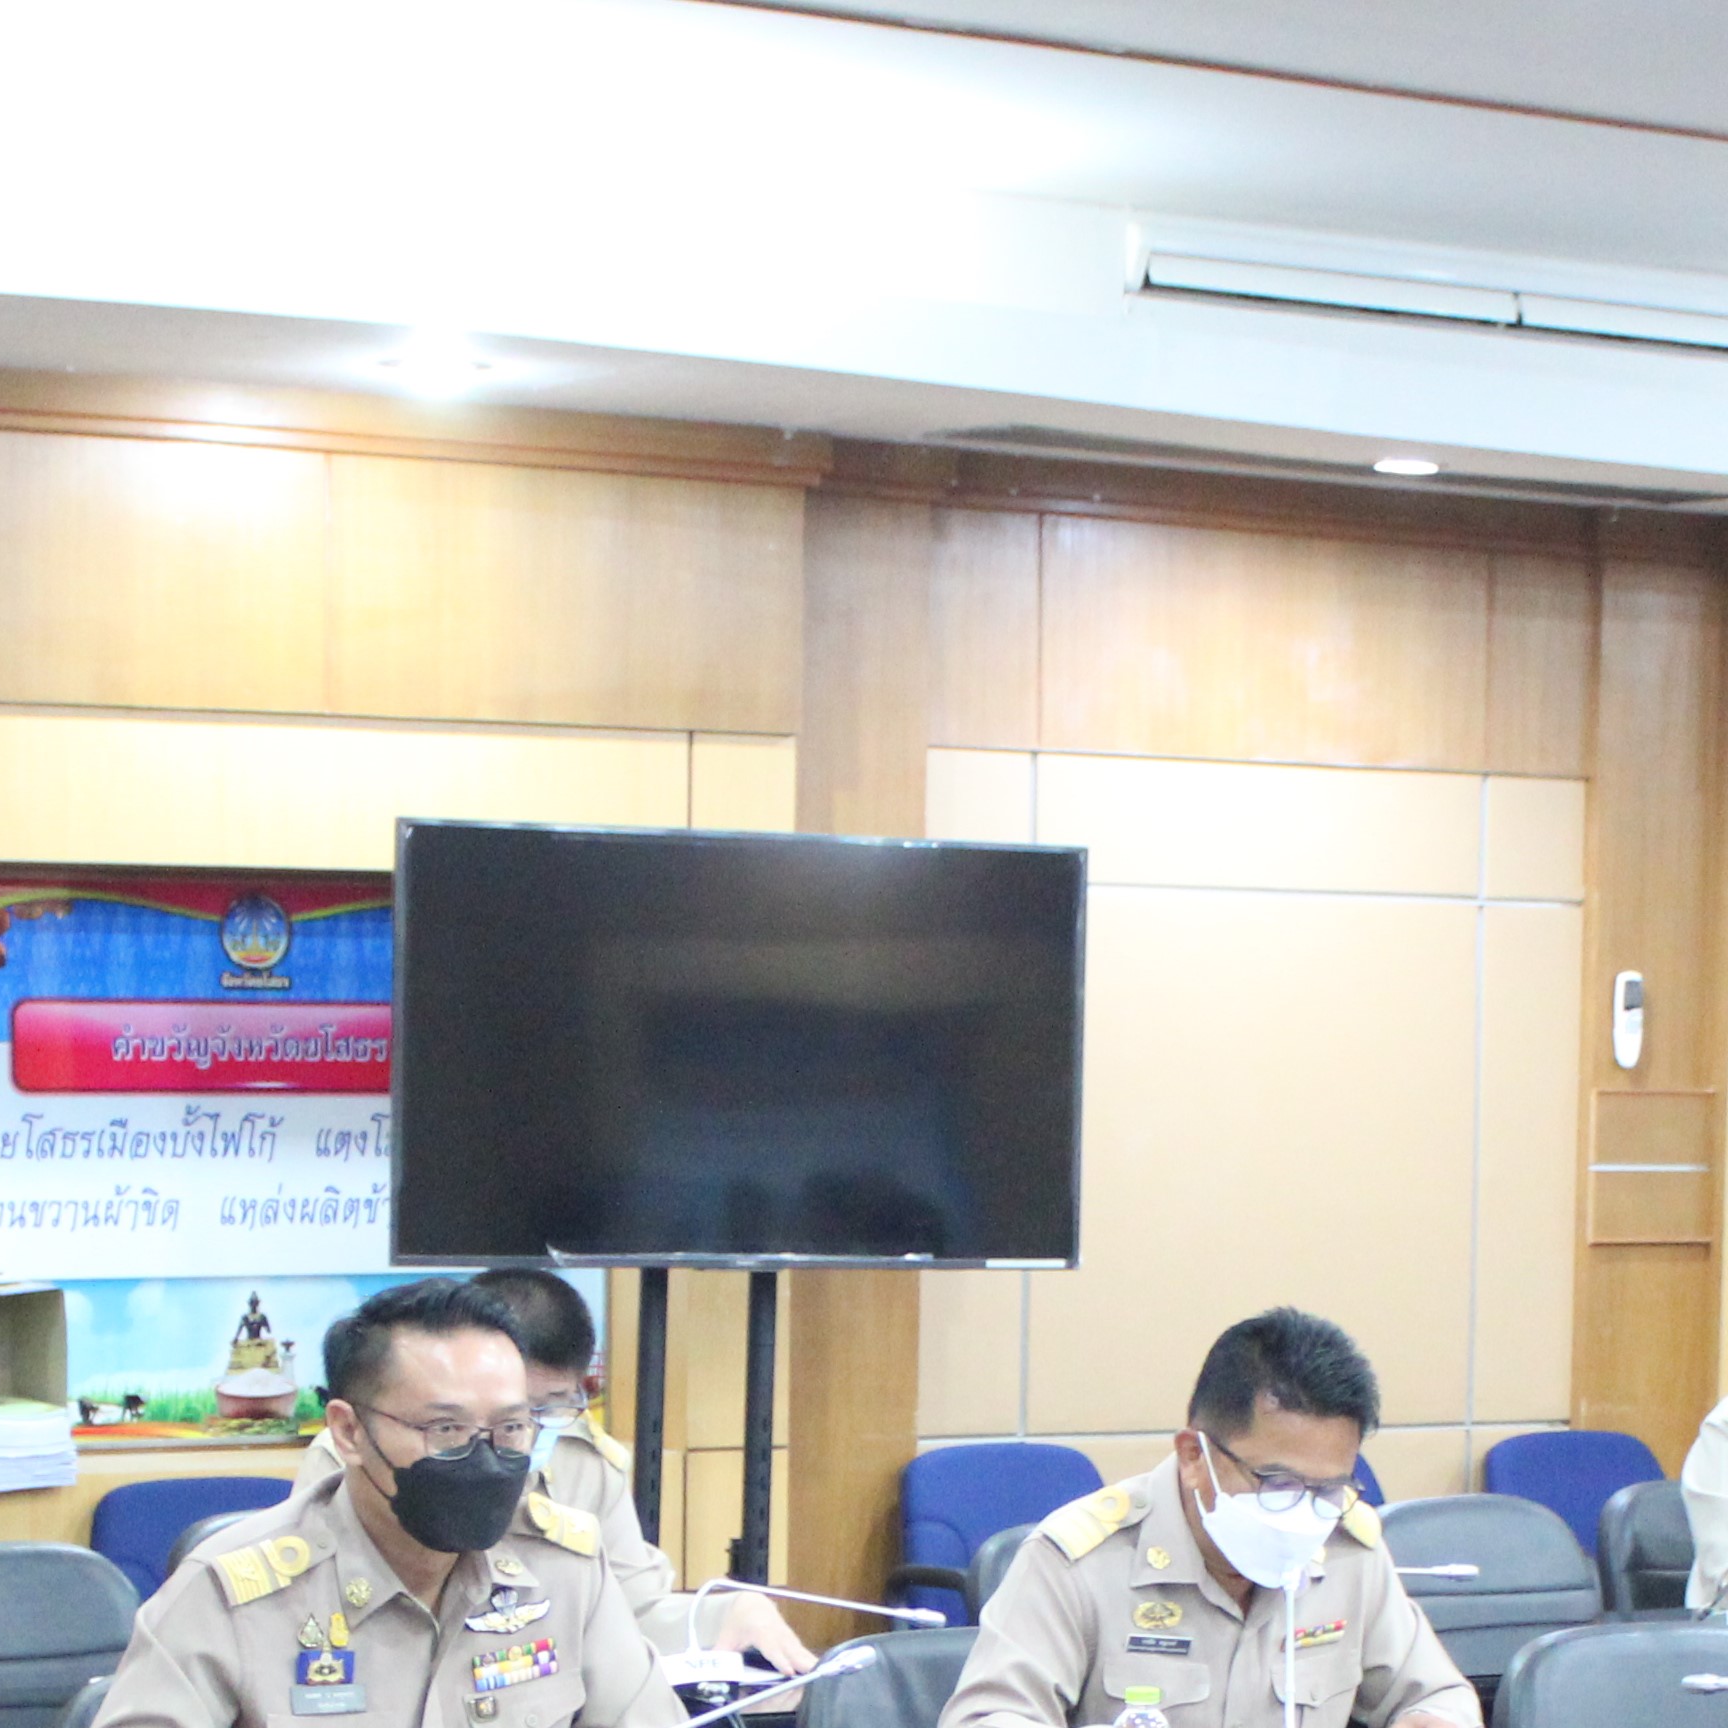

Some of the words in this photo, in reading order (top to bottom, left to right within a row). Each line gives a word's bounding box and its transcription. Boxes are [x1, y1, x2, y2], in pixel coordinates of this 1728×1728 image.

[111, 1022, 388, 1068] คำขวัญจังหวัดยโสธร
[315, 1113, 391, 1164] แตงโ
